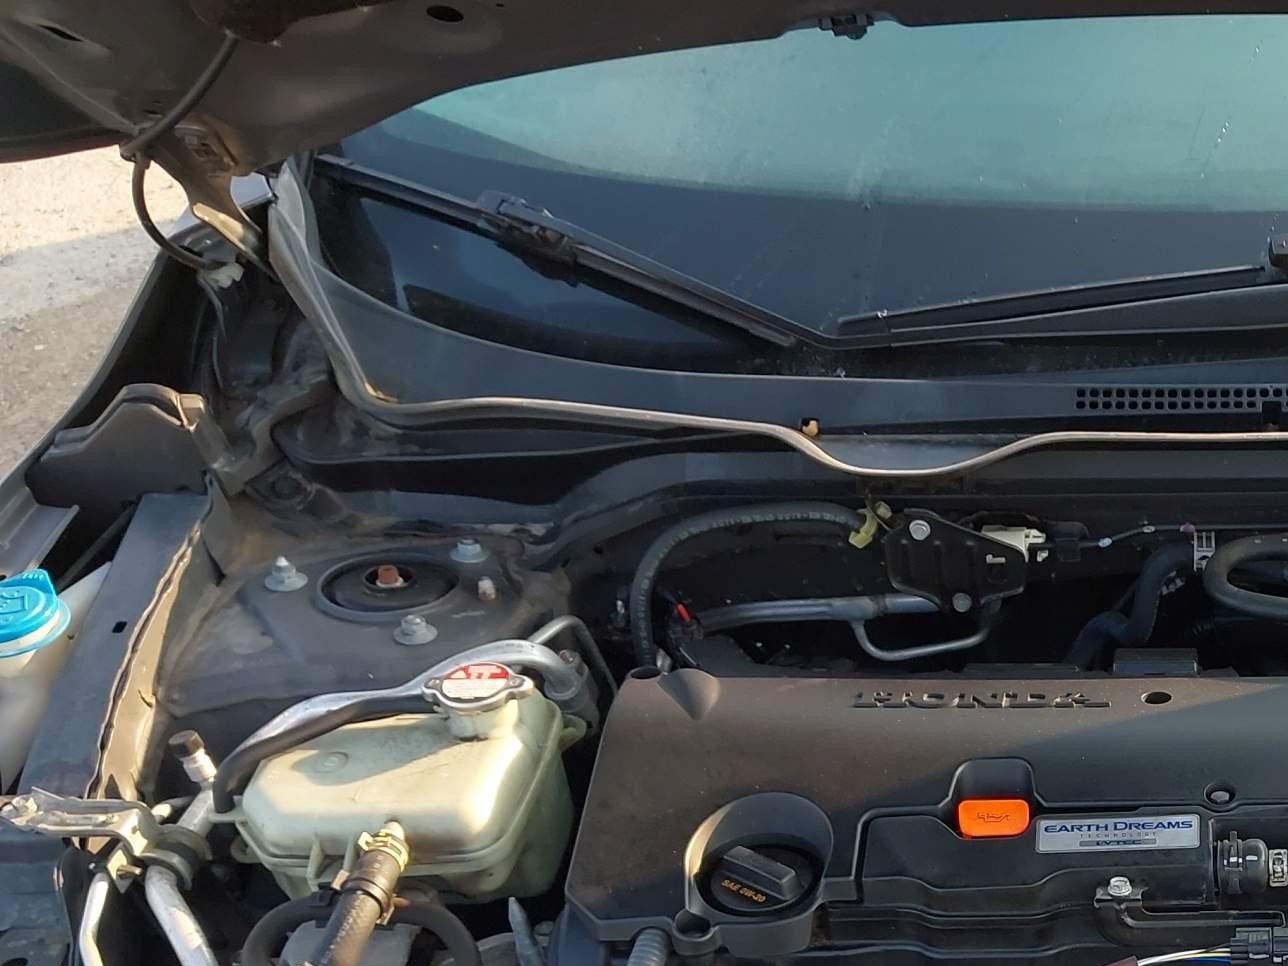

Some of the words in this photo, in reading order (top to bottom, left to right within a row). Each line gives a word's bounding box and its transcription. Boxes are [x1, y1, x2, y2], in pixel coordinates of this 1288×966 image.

[853, 691, 1112, 709] HONDA
[1044, 823, 1109, 833] EARTH
[1113, 820, 1193, 831] DREAMS
[721, 880, 741, 891] SAE
[740, 887, 766, 903] 0W-20
